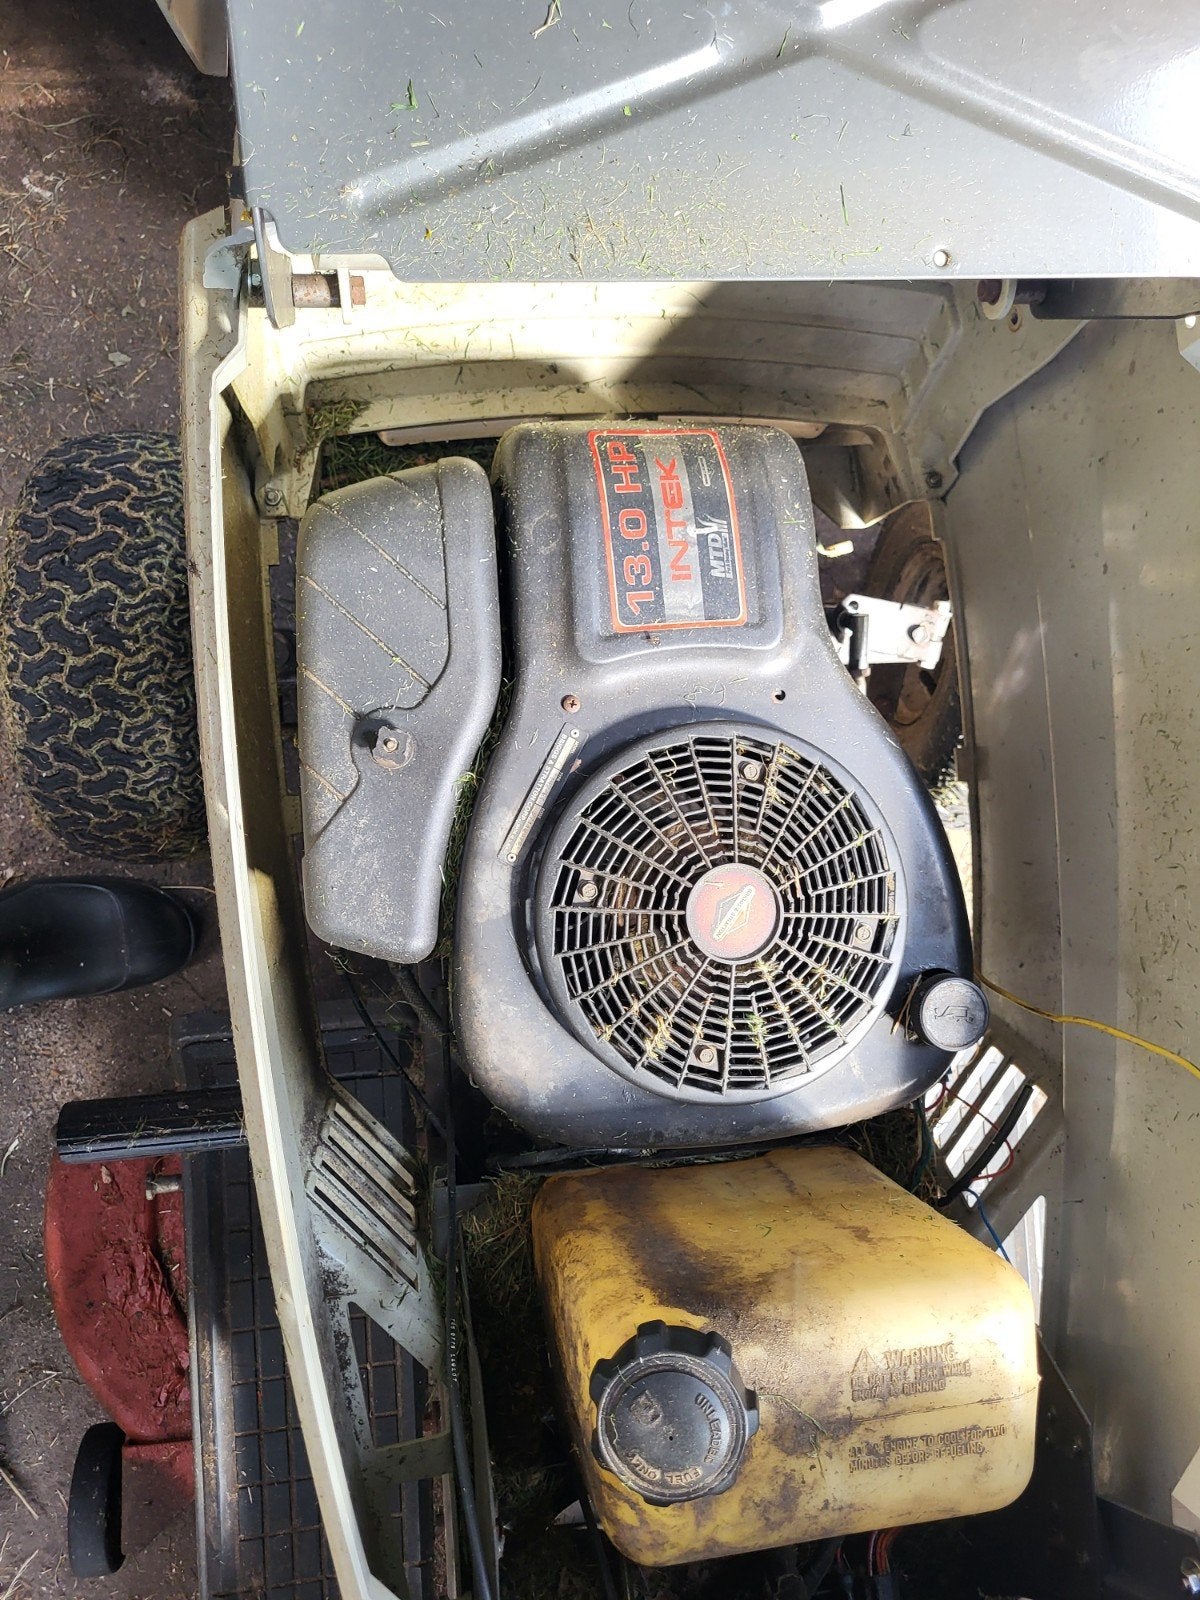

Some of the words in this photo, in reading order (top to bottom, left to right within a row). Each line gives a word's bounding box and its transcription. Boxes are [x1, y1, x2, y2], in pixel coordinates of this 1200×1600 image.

[608, 441, 643, 493] HP
[655, 456, 692, 582] INTEK
[619, 508, 654, 616] 13.0
[707, 533, 728, 578] MTD
[551, 733, 567, 759] BRIGGS
[531, 765, 551, 802] STRATTON
[884, 1342, 955, 1368] WARNING
[695, 1392, 722, 1464] UNLEADED
[987, 1423, 1007, 1439] TWO
[664, 1467, 703, 1485] FUEL
[895, 1449, 931, 1466] BEFORE
